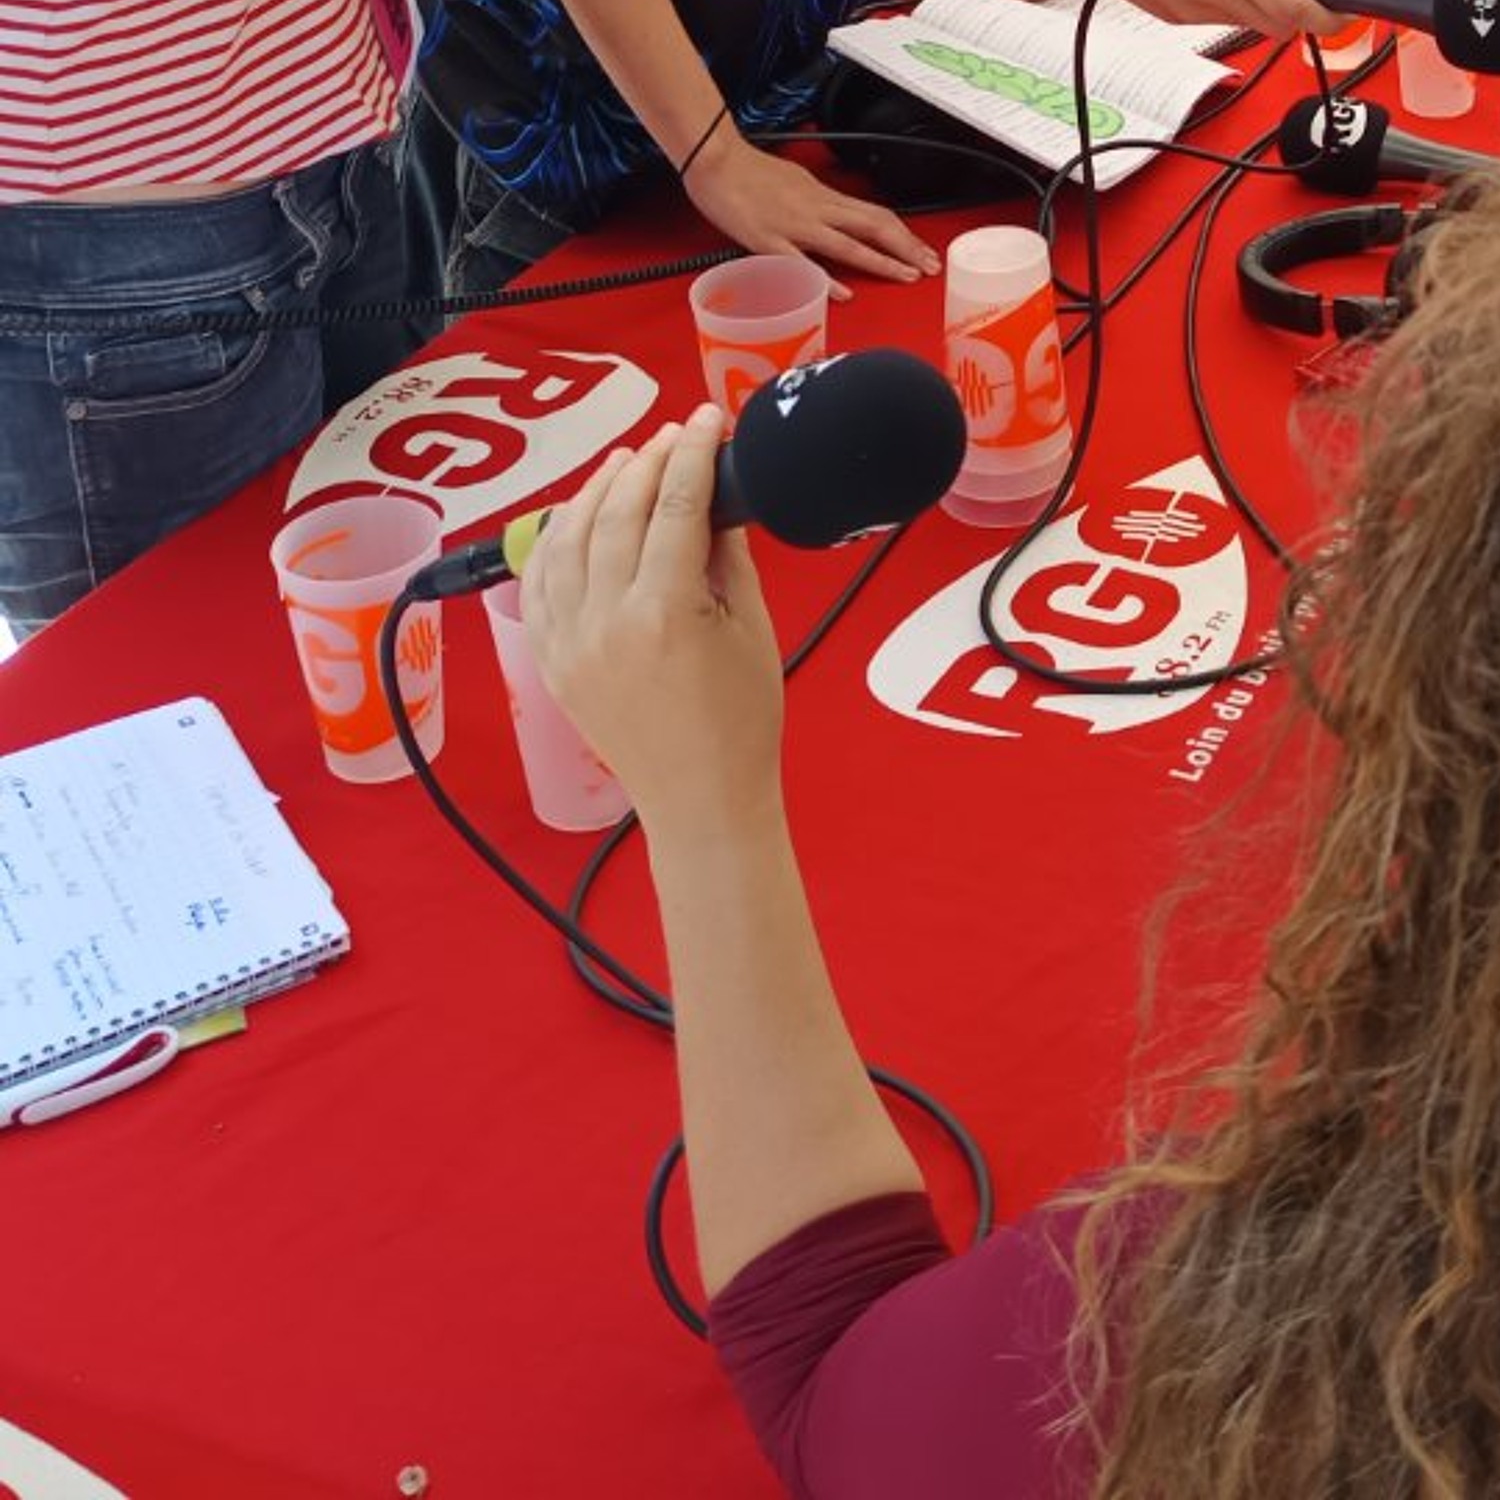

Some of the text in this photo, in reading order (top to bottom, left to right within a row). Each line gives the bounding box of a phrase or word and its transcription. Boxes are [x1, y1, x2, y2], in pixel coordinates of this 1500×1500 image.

[1205, 610, 1232, 632] FM
[1169, 725, 1229, 783] Loin
[1212, 689, 1254, 721] du
